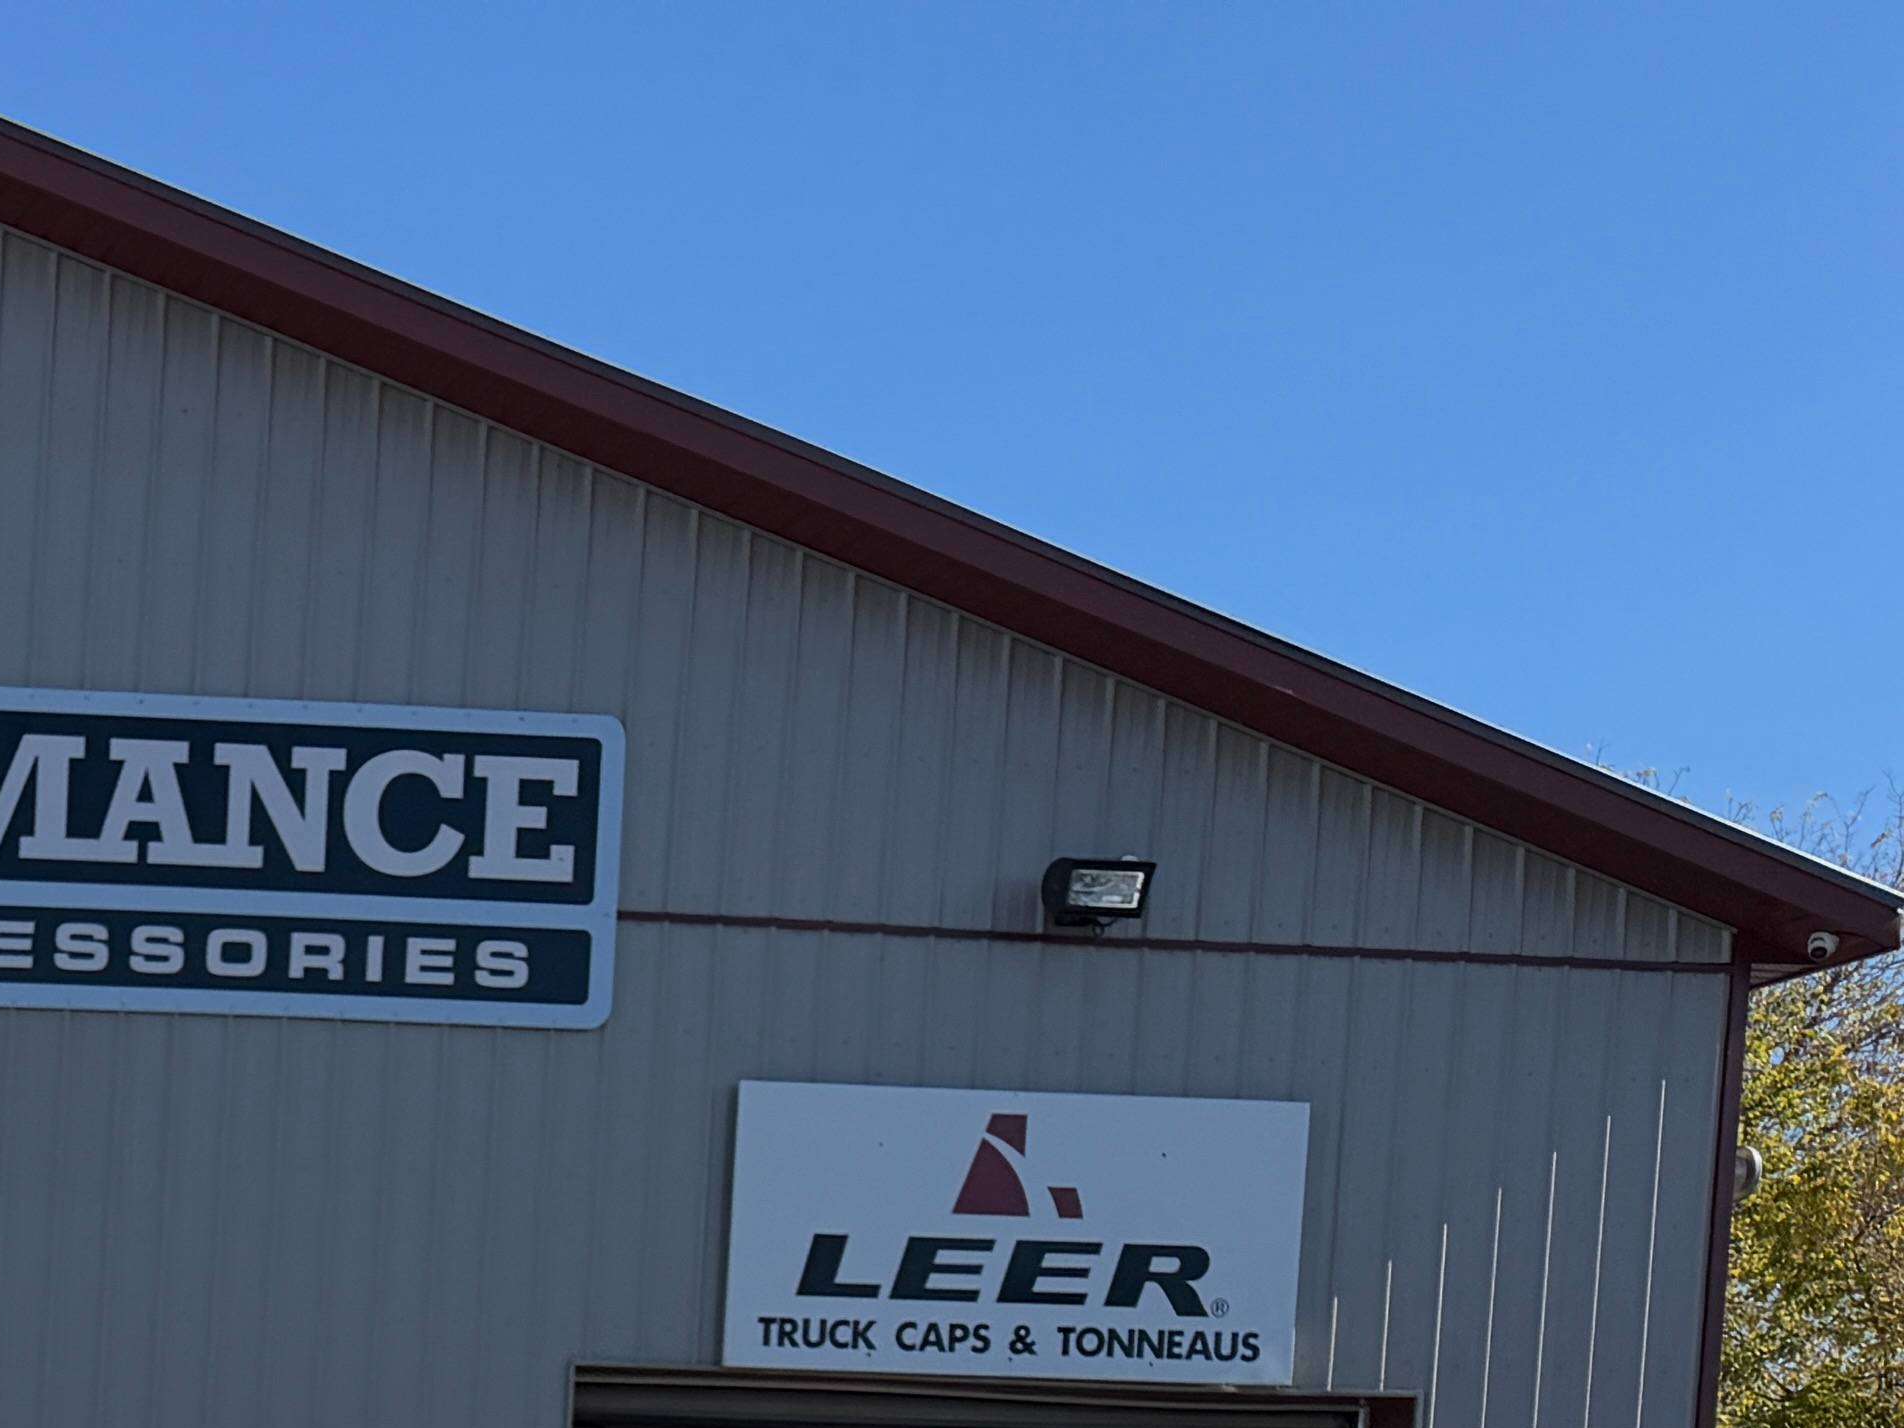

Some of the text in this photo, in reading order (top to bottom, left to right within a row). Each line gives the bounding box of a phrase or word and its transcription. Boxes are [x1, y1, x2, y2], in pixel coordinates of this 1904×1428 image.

[795, 1233, 1211, 1318] LEER
[757, 1316, 1261, 1364] TRUCK CAPS & TONNEAUS
